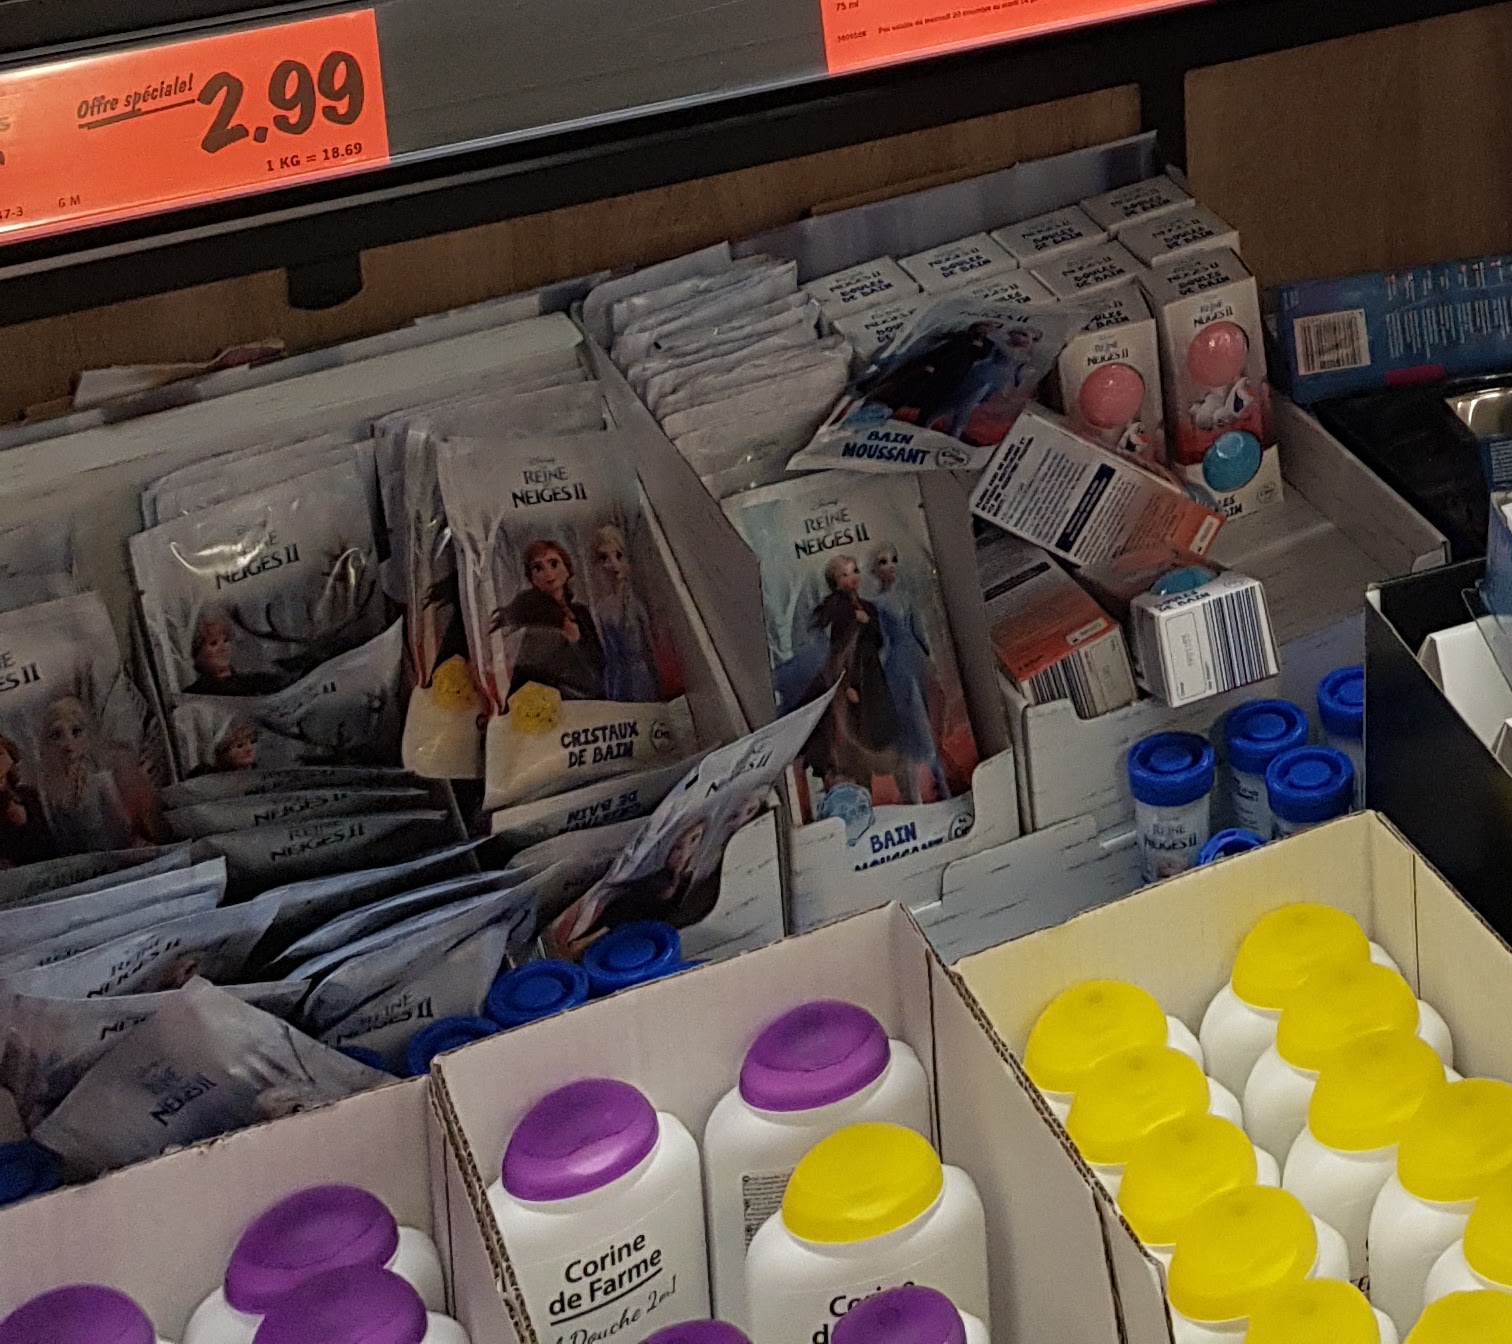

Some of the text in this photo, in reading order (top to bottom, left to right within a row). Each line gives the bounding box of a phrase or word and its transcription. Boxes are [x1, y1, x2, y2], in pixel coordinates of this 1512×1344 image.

[836, 2, 847, 11] 75
[77, 73, 194, 119] Offre spéciale!
[198, 50, 365, 154] 2.99
[267, 142, 363, 171] 1 KG 18.69
[868, 430, 914, 445] BAIN
[842, 441, 931, 465] MOUSSANT
[523, 465, 568, 484] REINE
[512, 486, 573, 508] NEIGES
[803, 508, 852, 534] REINE
[795, 529, 853, 559] NEIGES
[560, 721, 639, 748] CRISTAUX
[569, 742, 634, 768] DE BAIN
[870, 821, 918, 853] BAIN
[565, 1233, 647, 1284] Corine
[549, 1248, 663, 1316] de Farme
